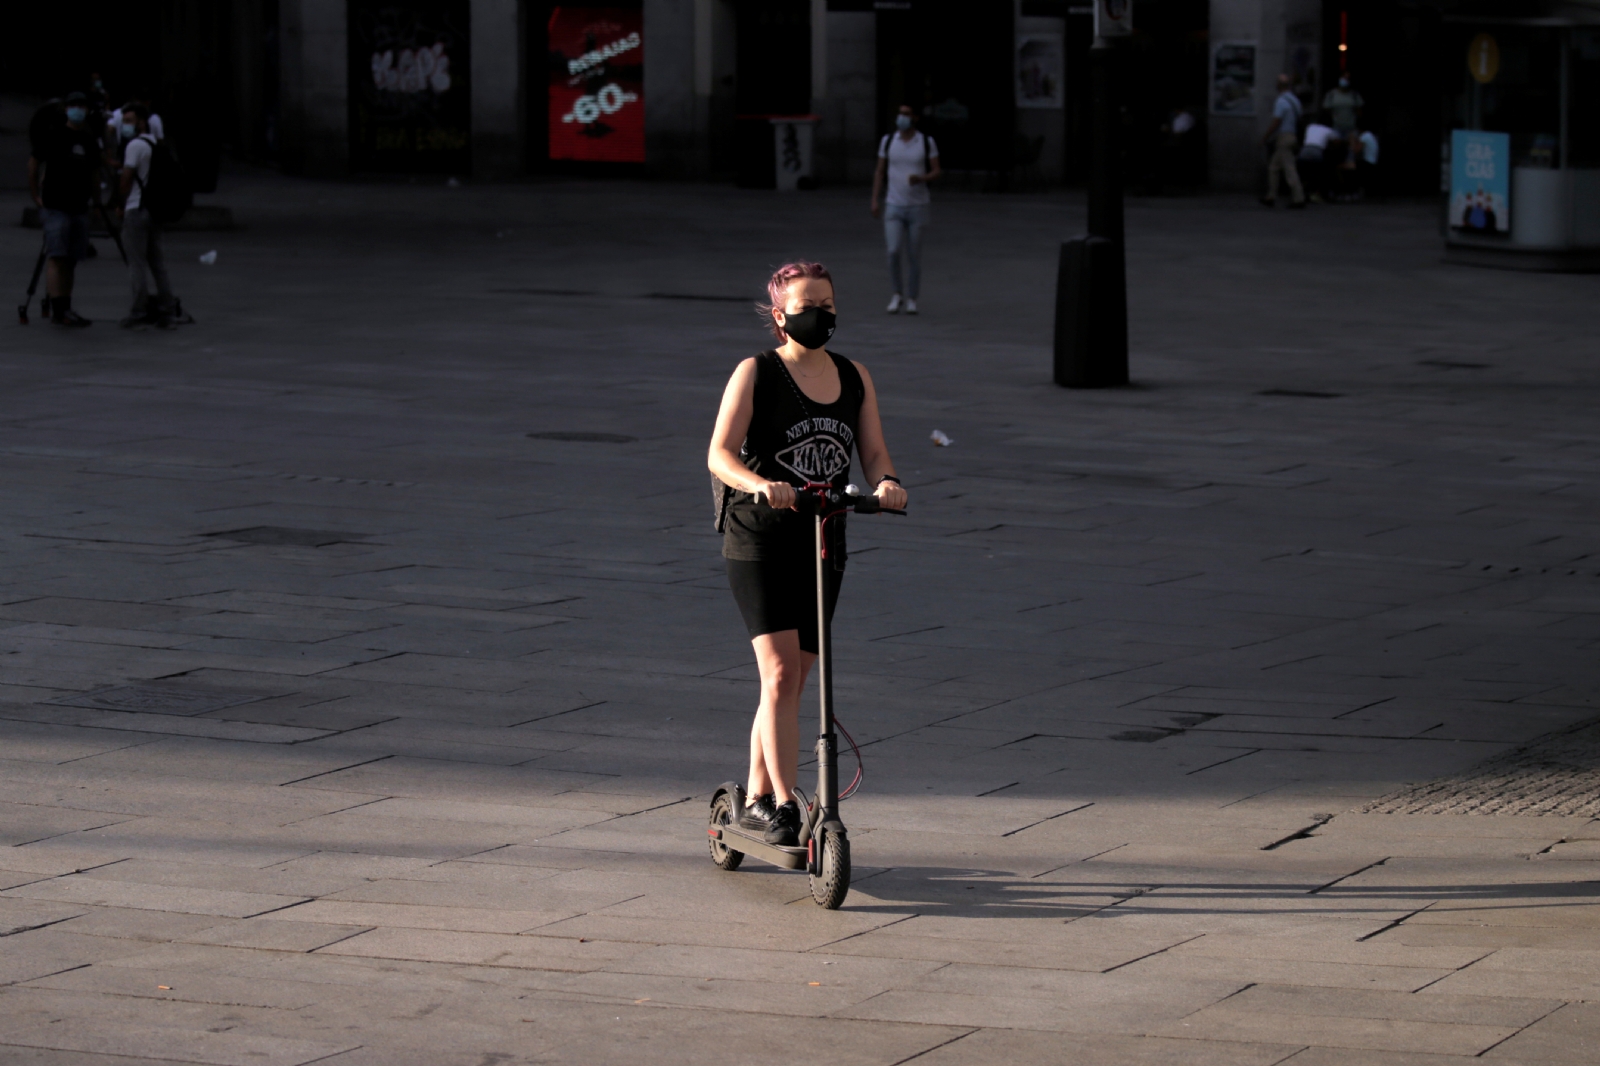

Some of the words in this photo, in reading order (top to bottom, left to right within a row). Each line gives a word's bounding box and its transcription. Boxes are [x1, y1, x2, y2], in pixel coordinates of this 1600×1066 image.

[785, 419, 811, 443] NEW
[812, 417, 839, 434] YORK
[792, 443, 844, 476] KINGS
